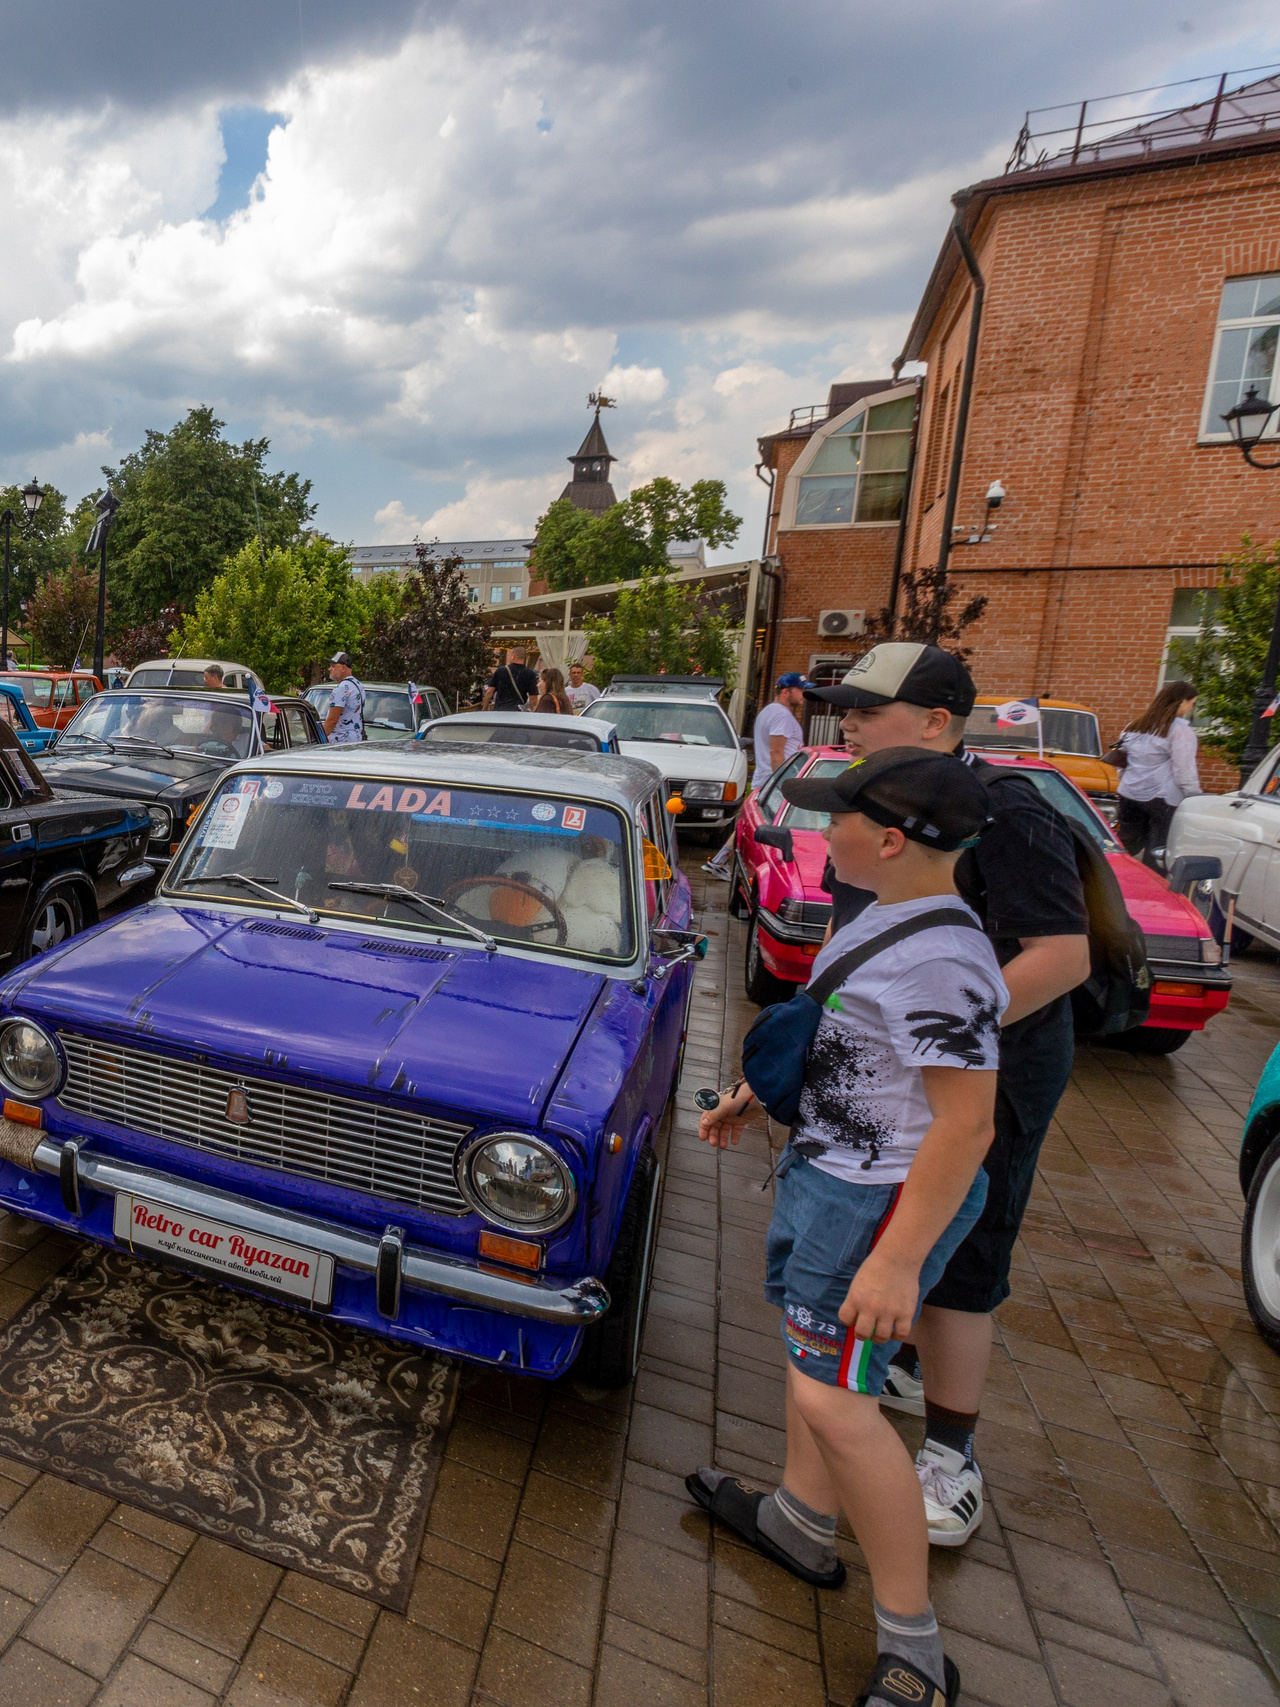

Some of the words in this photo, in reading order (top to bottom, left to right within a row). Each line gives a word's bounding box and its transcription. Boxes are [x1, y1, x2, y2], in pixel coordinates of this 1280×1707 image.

[346, 784, 452, 816] LADA
[133, 1204, 185, 1237] Retro
[189, 1228, 223, 1249] car
[228, 1234, 310, 1278] Ryazan
[158, 1239, 176, 1252] клуб
[177, 1243, 227, 1267] классических
[228, 1262, 282, 1284] автомобилей
[809, 1340, 838, 1356] CLUB
